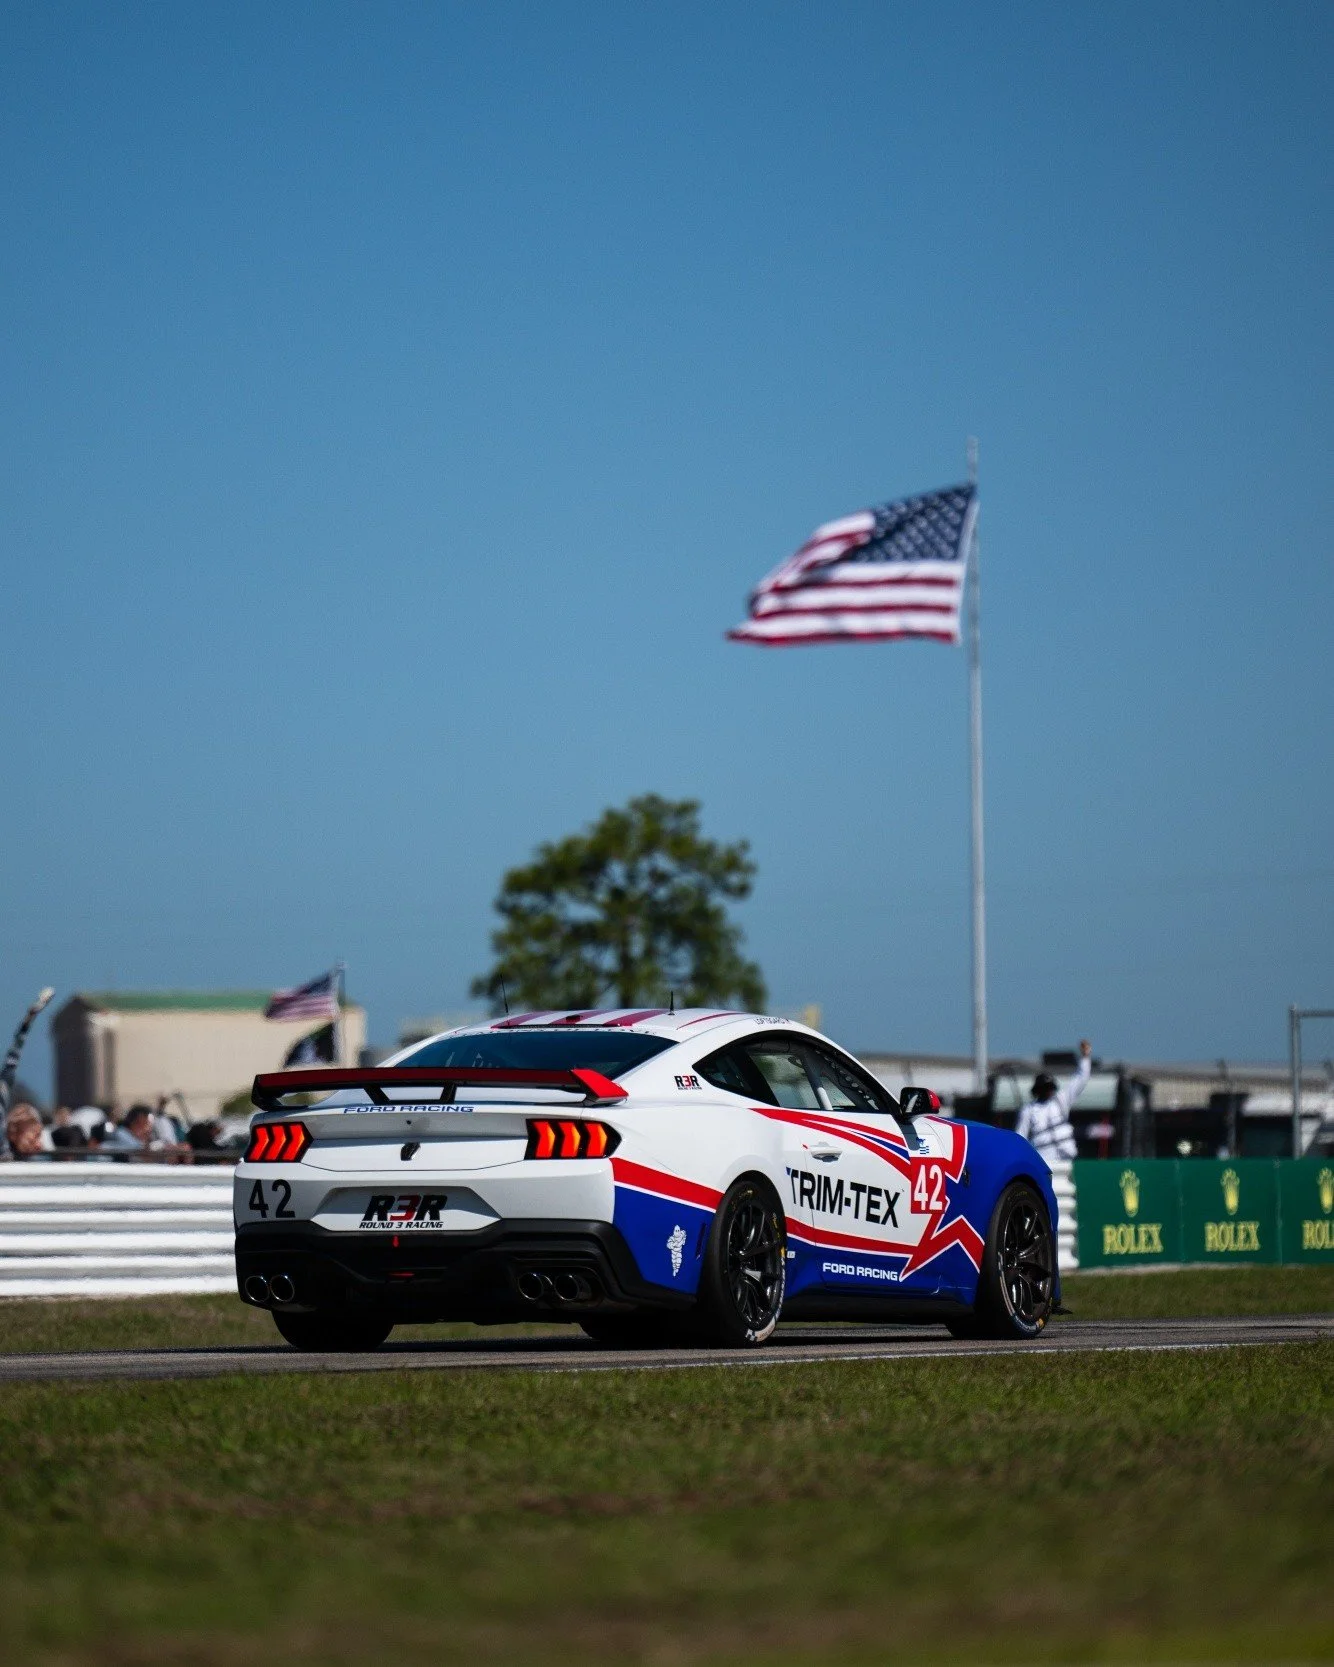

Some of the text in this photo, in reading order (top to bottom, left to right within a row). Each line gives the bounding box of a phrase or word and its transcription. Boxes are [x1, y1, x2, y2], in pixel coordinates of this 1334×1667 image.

[674, 1075, 700, 1087] R3R
[343, 1105, 475, 1114] FORD RACING
[249, 1179, 296, 1218] 42
[786, 1166, 900, 1229] TRIM-TEX
[913, 1164, 944, 1212] 42
[361, 1195, 448, 1222] R3R
[359, 1221, 444, 1229] ROUND 3 RACING
[1102, 1223, 1164, 1254] ROLEX
[1204, 1221, 1260, 1252] ROLEX
[1302, 1219, 1334, 1250] ROL
[822, 1262, 898, 1281] FORD RACING
